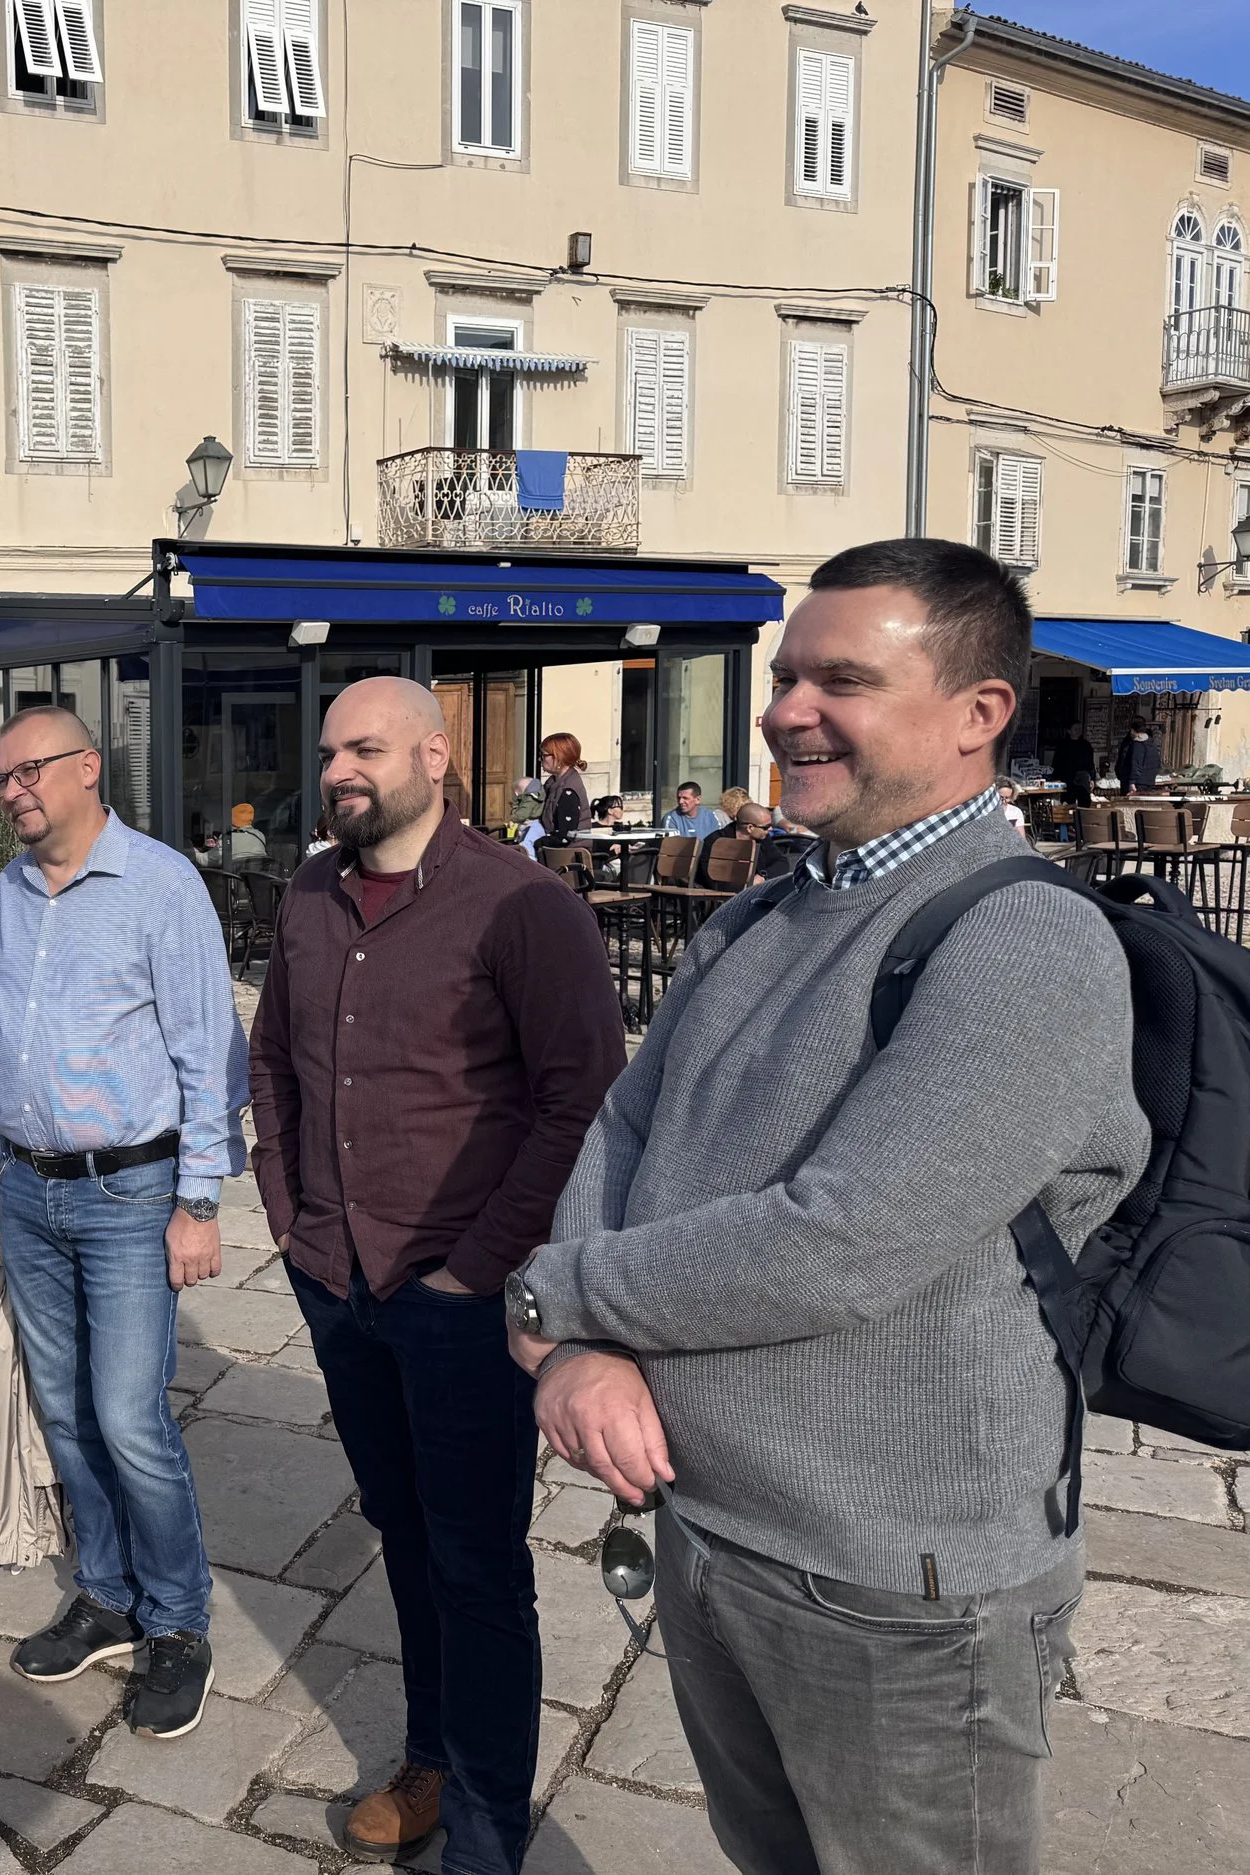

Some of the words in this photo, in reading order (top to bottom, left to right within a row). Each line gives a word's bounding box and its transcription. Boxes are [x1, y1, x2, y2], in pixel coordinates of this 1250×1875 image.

[468, 603, 499, 618] caffe
[507, 594, 564, 618] Rialto
[1133, 676, 1178, 690] Souvenirs
